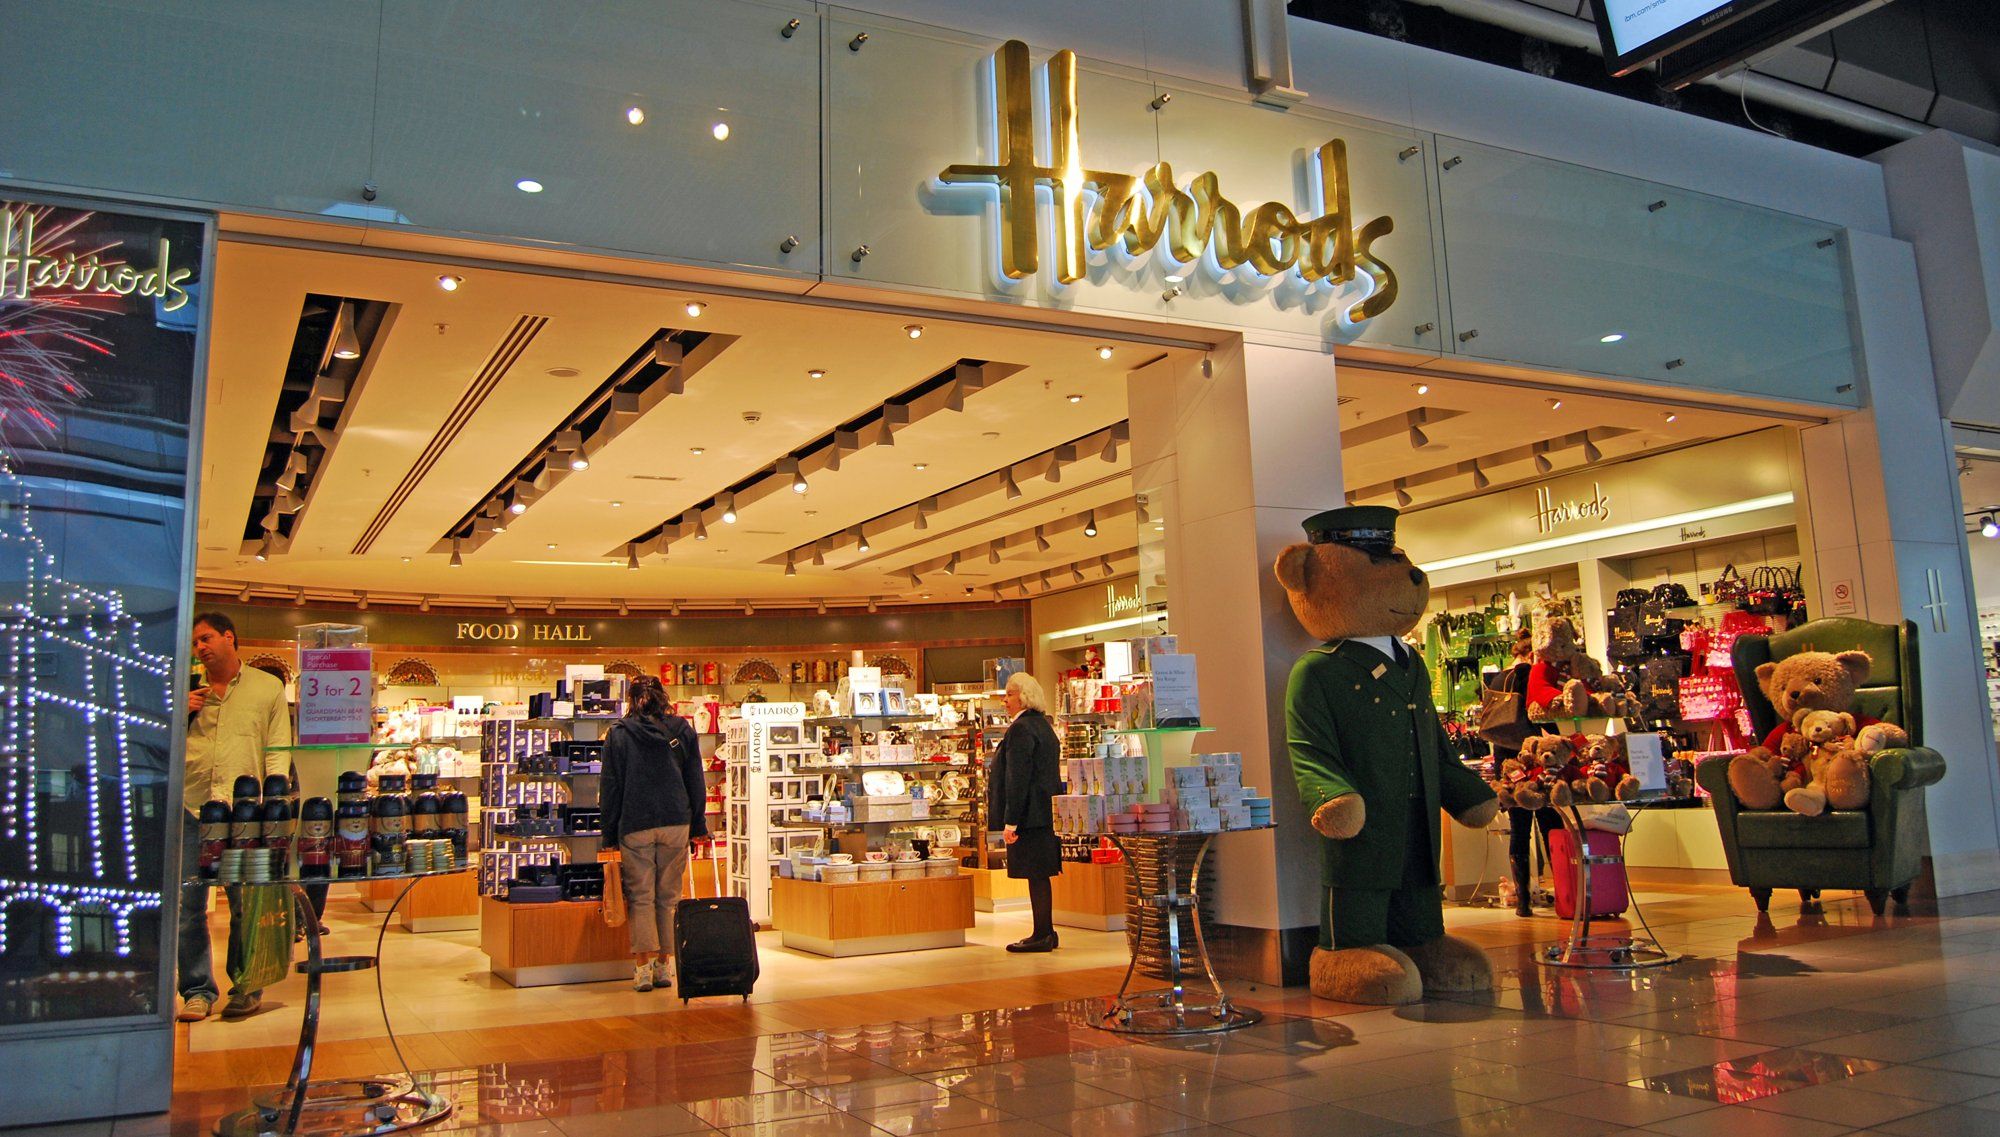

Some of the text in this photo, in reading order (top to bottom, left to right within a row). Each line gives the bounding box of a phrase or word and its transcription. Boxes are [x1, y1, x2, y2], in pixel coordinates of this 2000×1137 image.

[1701, 6, 1733, 26] SAMSUNG
[939, 39, 1398, 323] Harrods
[0, 208, 191, 312] Harrods
[1529, 482, 1610, 535] Harrods
[1679, 526, 1705, 541] Harrods
[1494, 559, 1515, 573] Harrods
[456, 622, 592, 641] FOOD HALL
[306, 653, 331, 662] Special
[307, 677, 362, 697] 3 for 2
[752, 722, 763, 764] LLADRÓ
